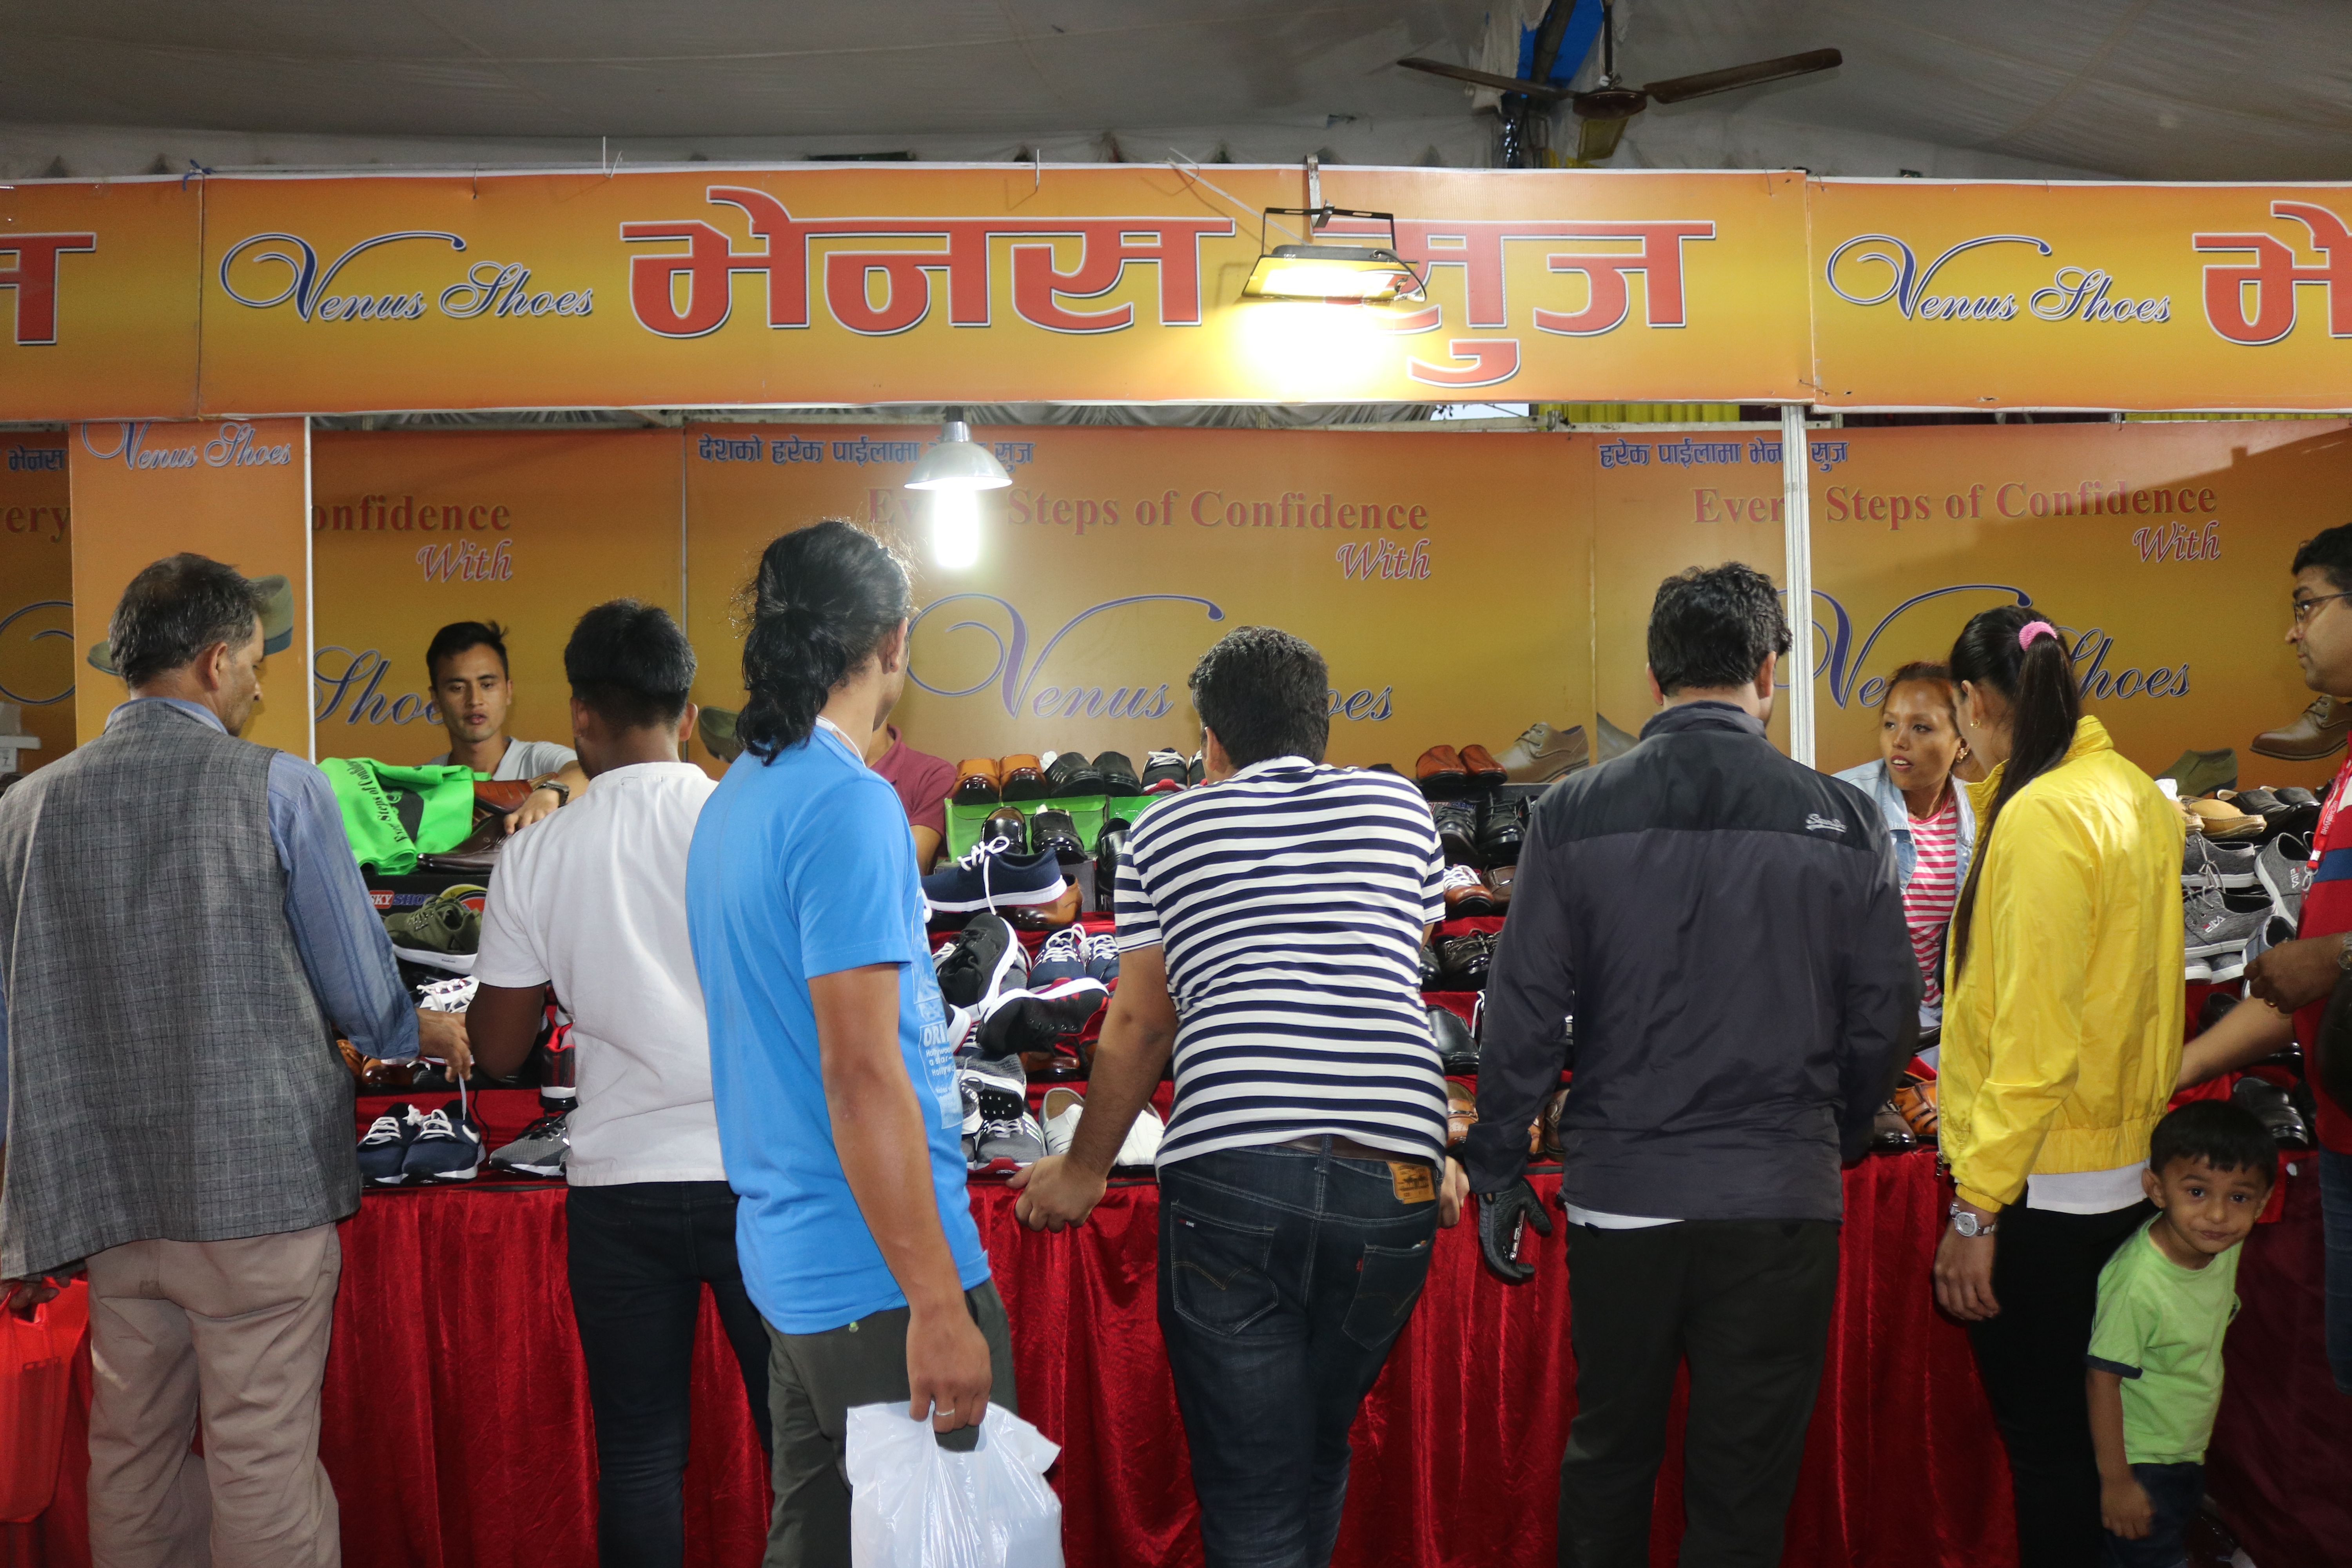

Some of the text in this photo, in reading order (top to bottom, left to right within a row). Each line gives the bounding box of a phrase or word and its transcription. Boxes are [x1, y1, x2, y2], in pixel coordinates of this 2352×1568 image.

[220, 232, 593, 321] Venus Shoes
[1826, 233, 2172, 322] Venus Shoes
[2192, 201, 2352, 345] भे
[82, 422, 291, 470] Venus Shoes
[698, 434, 765, 462] देशको
[771, 434, 826, 465] हरेक
[1598, 438, 1650, 468] हरेक
[1748, 436, 1784, 464] भेन
[5, 507, 70, 543] ery
[312, 495, 510, 531] onfidence
[1007, 488, 1428, 535] Steps of Confidence
[1694, 481, 2217, 530] Ever Steps of Confidence
[416, 539, 512, 583] With
[1336, 538, 1432, 581] With
[2132, 521, 2221, 563] With
[907, 593, 1225, 719] Venus
[313, 646, 444, 725] Shoe
[393, 894, 436, 906] SHO
[924, 1024, 949, 1047] ORI
[926, 1047, 951, 1058] Hollywoo
[931, 1063, 956, 1076] Hollywo
